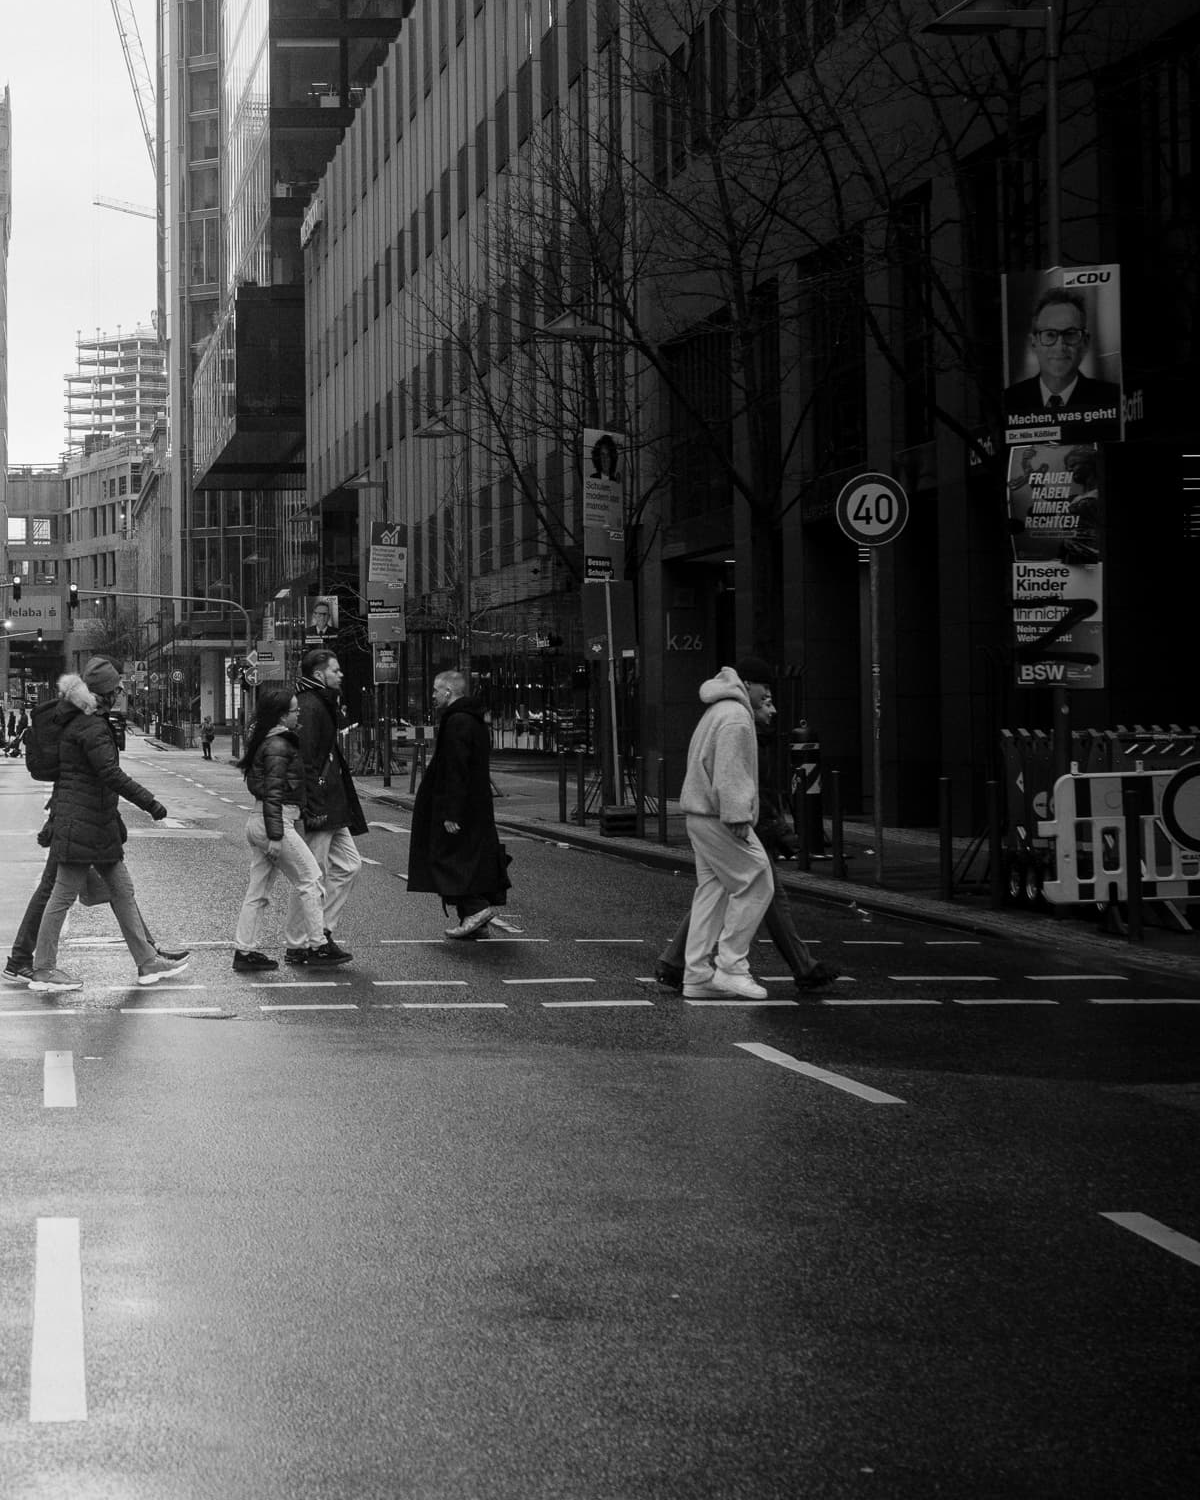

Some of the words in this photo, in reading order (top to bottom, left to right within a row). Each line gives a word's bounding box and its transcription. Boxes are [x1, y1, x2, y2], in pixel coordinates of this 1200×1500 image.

[1076, 271, 1112, 285] CDU
[1008, 412, 1056, 425] Machen,
[1057, 411, 1082, 421] was
[1083, 407, 1117, 424] geht!
[1028, 471, 1074, 485] FRAUEN
[1031, 486, 1072, 499] HABEN
[853, 493, 893, 525] 40
[1032, 501, 1071, 514] IMMER
[1024, 515, 1080, 529] RECHT(E)!
[1016, 565, 1070, 578] Unsere
[1016, 579, 1067, 591] Kinder
[1017, 625, 1037, 633] Nein
[1021, 664, 1065, 680] BSW
